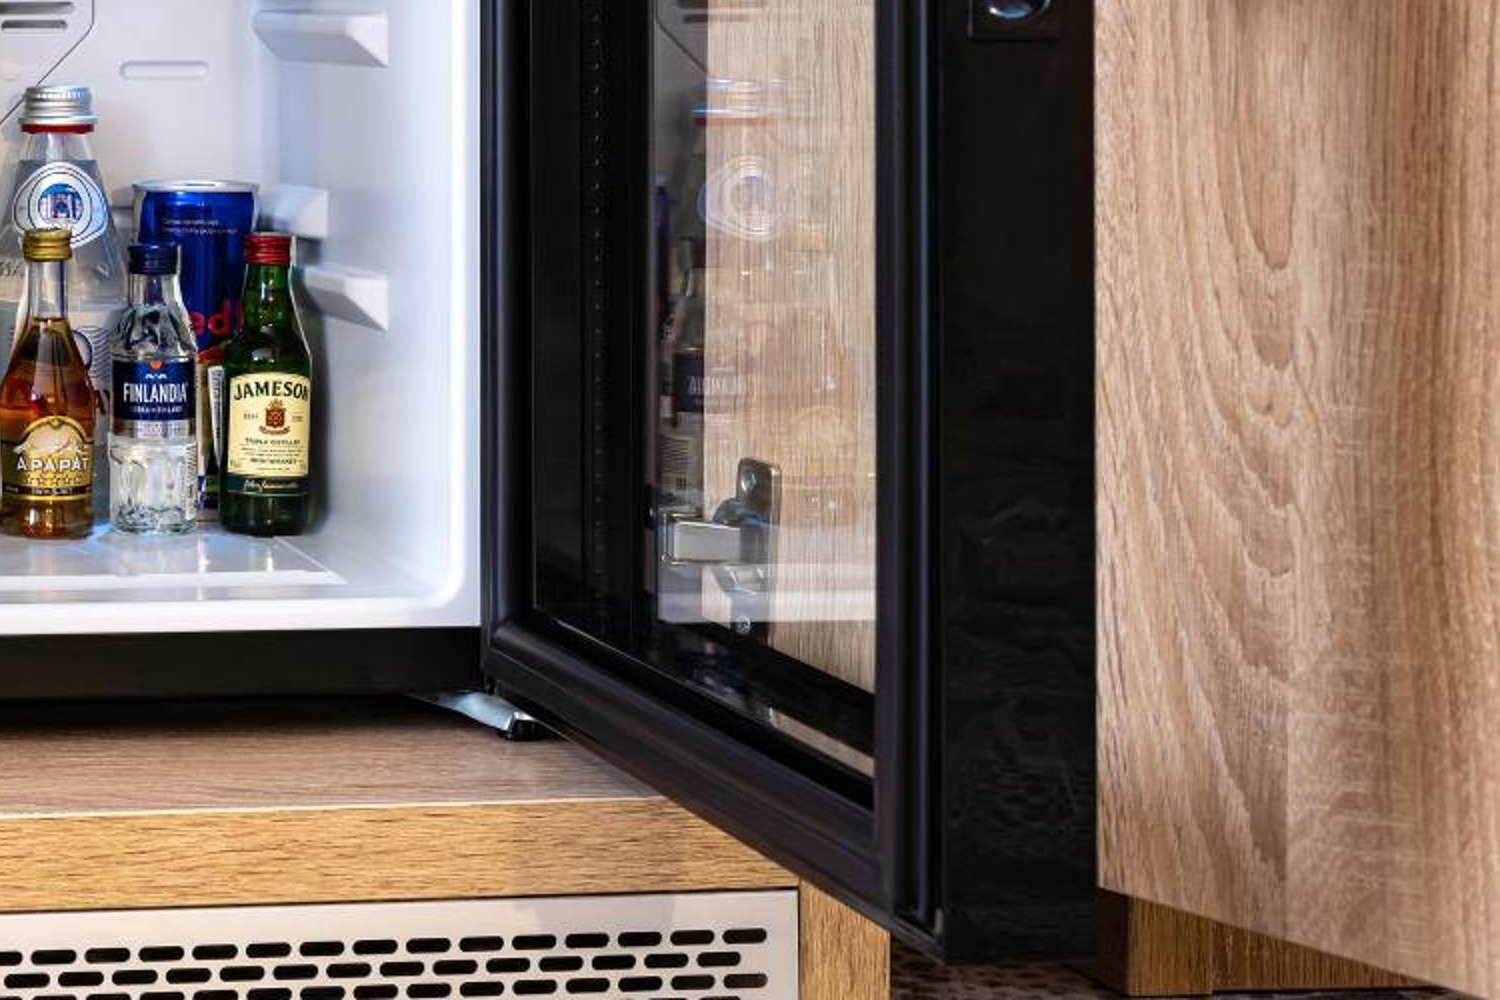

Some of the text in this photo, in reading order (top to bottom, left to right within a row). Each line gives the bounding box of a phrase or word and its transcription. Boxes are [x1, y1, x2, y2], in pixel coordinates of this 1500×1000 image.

[188, 297, 229, 337] ed
[123, 382, 188, 403] FINLANDIA
[233, 380, 308, 402] JAMESON
